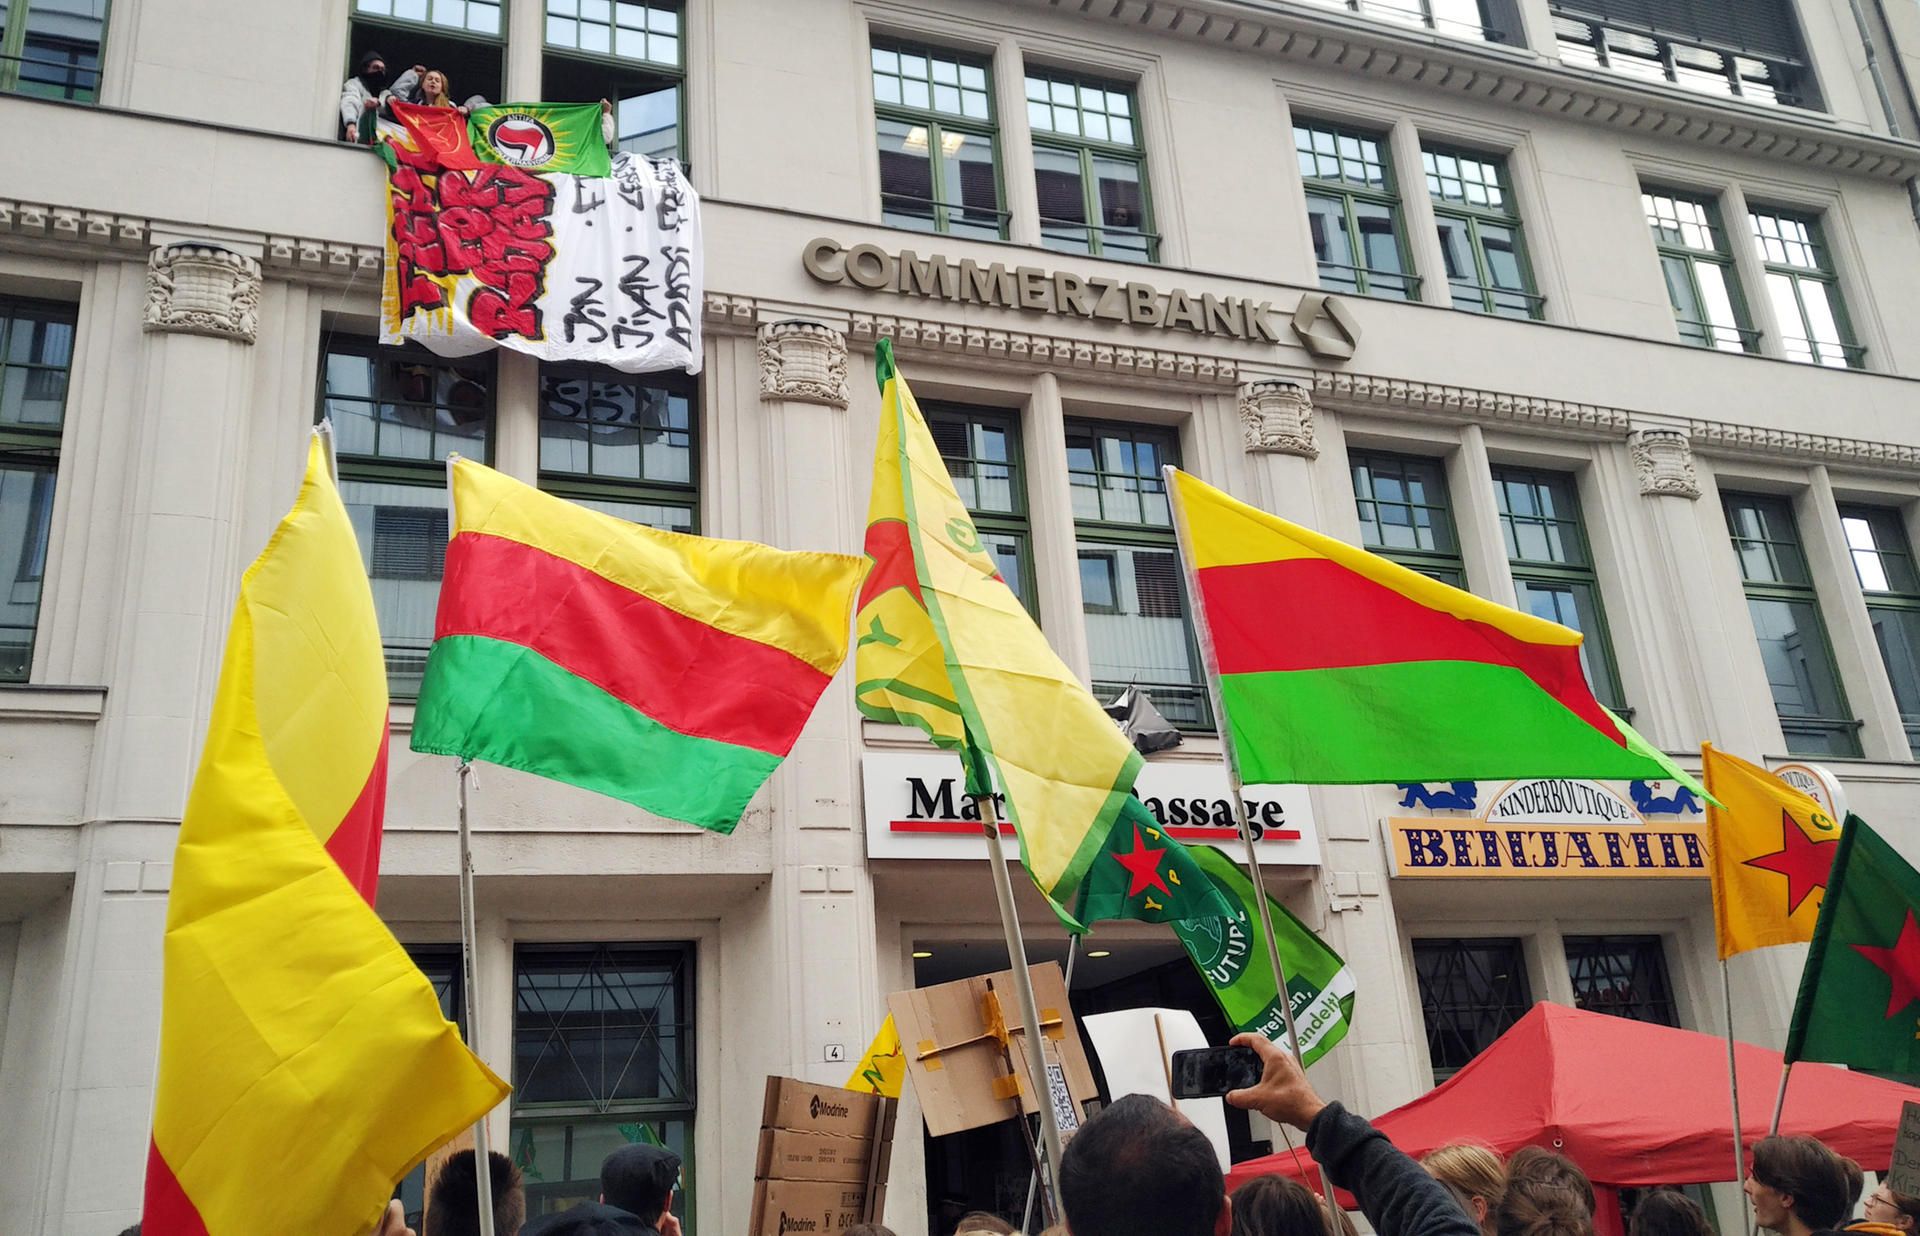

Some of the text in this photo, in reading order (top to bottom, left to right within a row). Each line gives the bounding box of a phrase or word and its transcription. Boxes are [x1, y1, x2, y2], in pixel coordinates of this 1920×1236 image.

[507, 114, 535, 124] ANTIFA
[802, 237, 1282, 344] COMMERZBANK
[906, 777, 1285, 842] Mar assage
[1498, 779, 1630, 822] KINDERBOUTIQUE
[1399, 828, 1710, 868] BENJAMIN
[831, 1046, 838, 1059] 4
[819, 1101, 849, 1118] Modrine
[785, 1217, 816, 1233] Modrine
